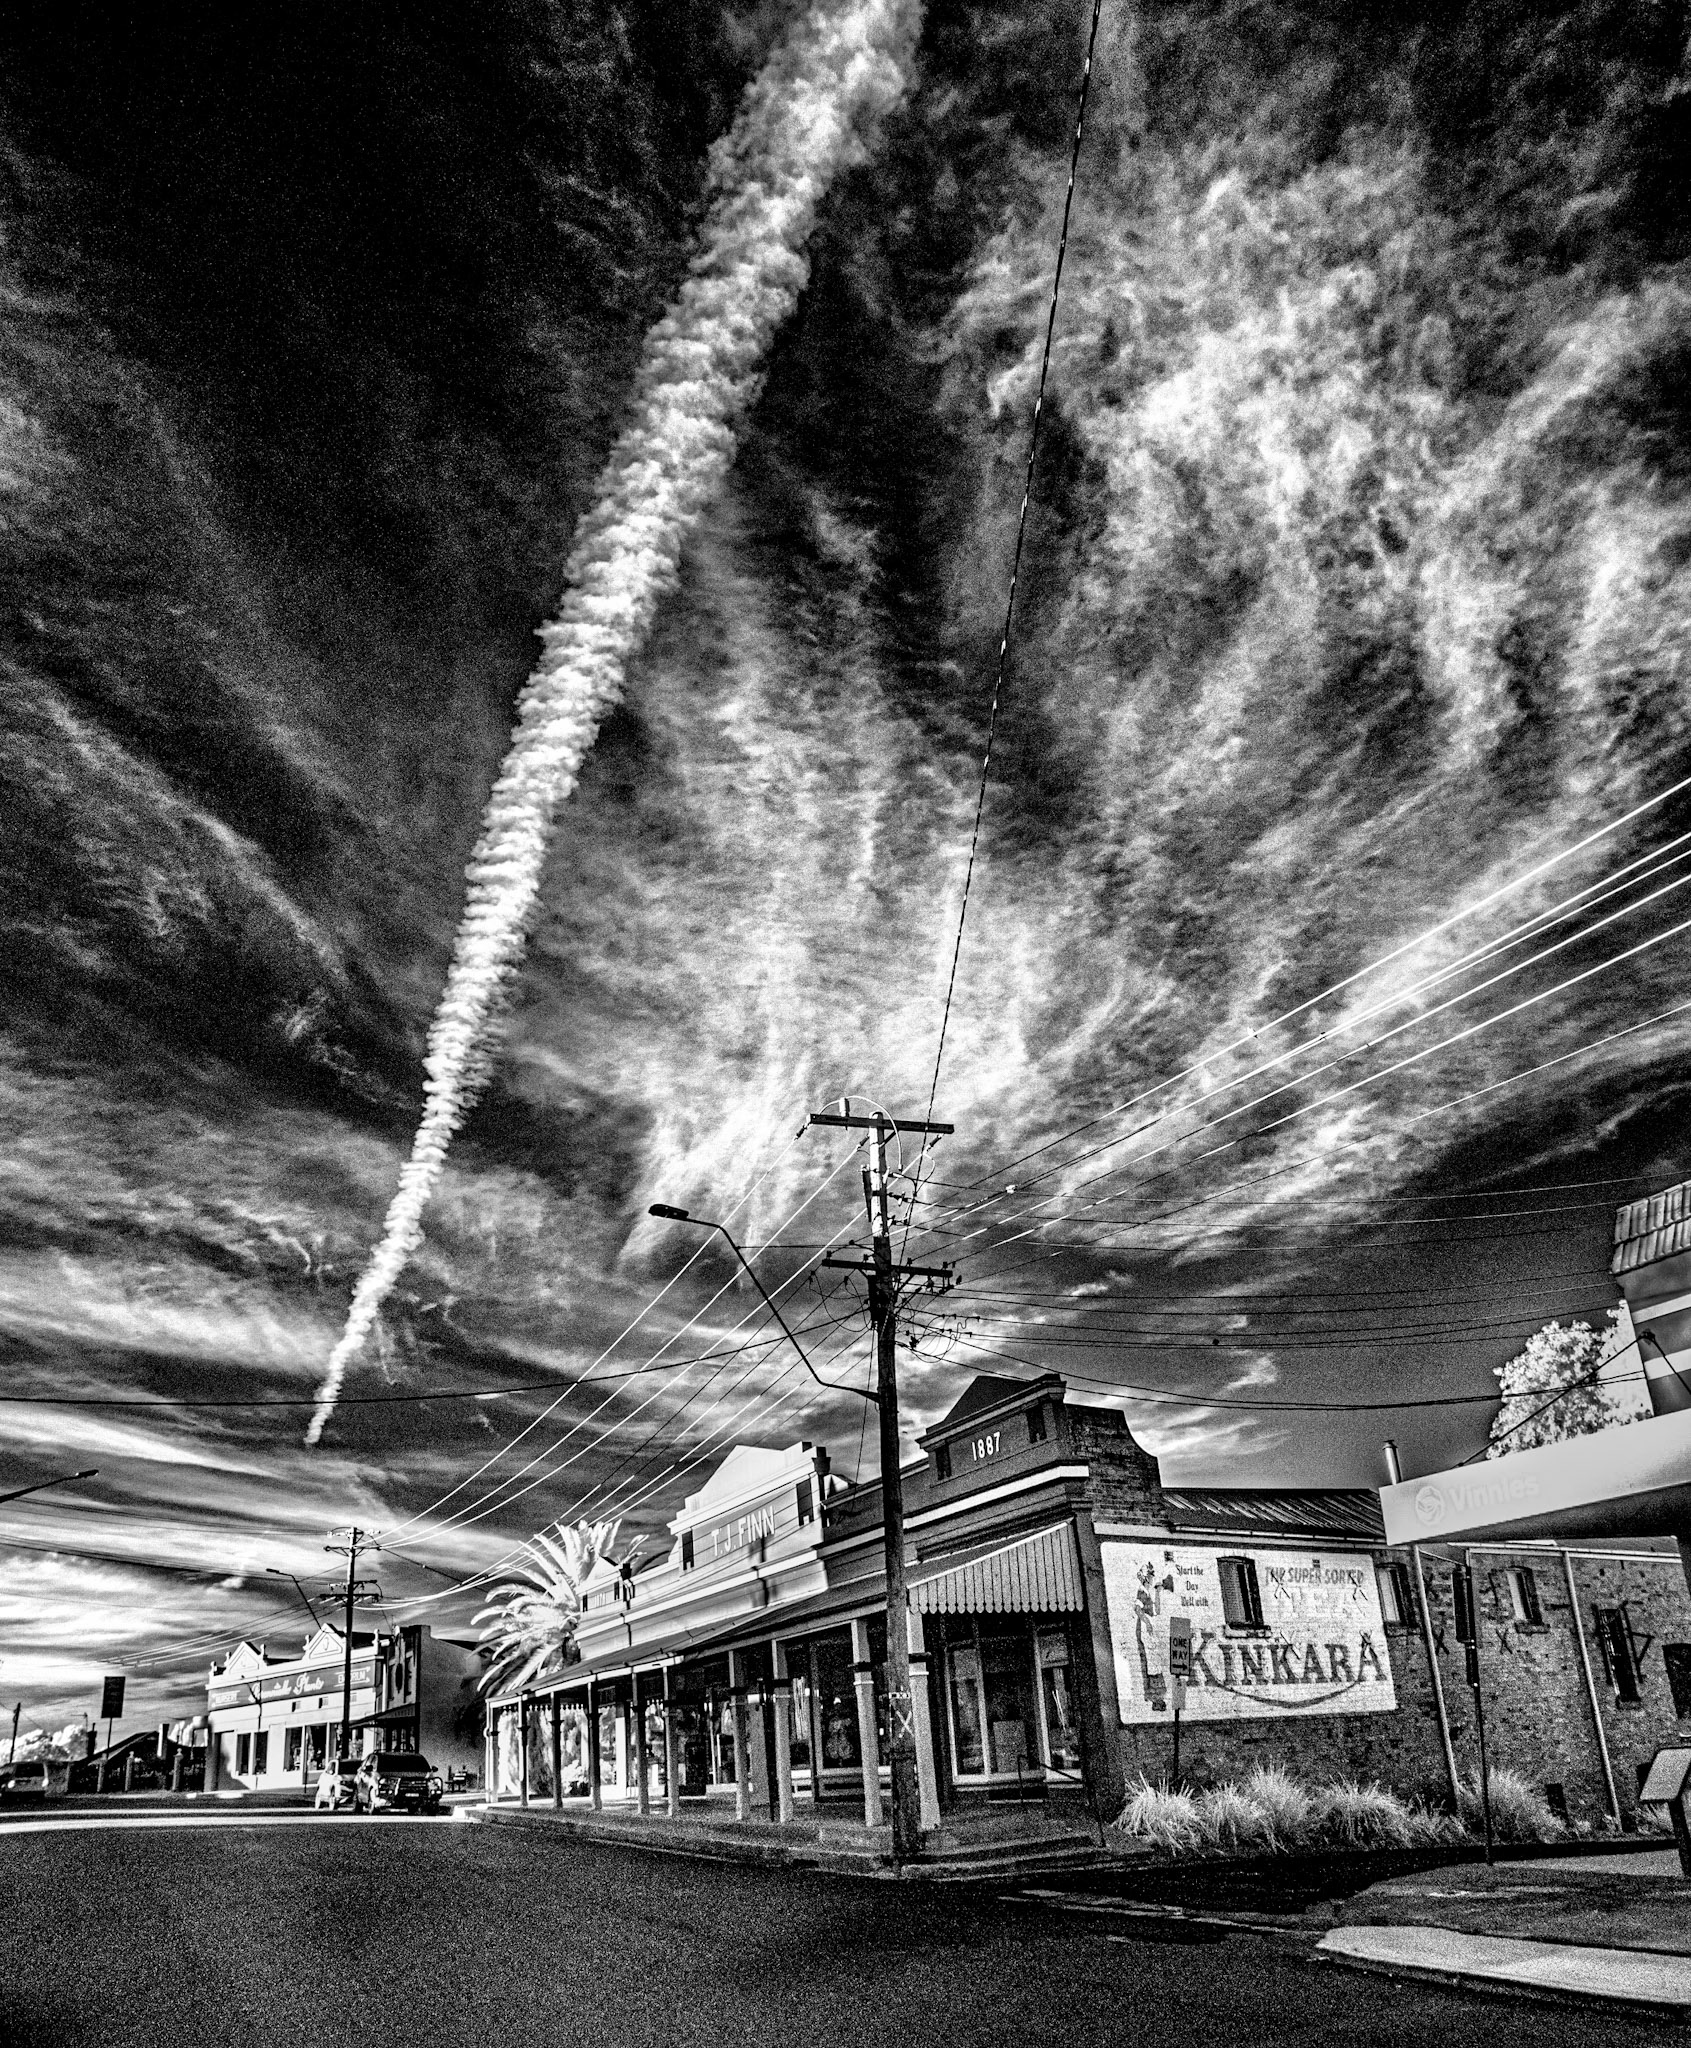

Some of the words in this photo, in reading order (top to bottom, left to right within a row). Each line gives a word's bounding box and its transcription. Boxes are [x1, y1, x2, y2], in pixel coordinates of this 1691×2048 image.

[972, 1431, 1000, 1461] 1887
[1448, 1476, 1540, 1512] Vinnies
[738, 1505, 774, 1548] FINN
[1186, 1580, 1199, 1593] Day
[1288, 1567, 1321, 1584] SUPER
[1172, 1637, 1188, 1649] ONE
[1172, 1649, 1188, 1660] WAY
[1187, 1632, 1387, 1686] KINKARA
